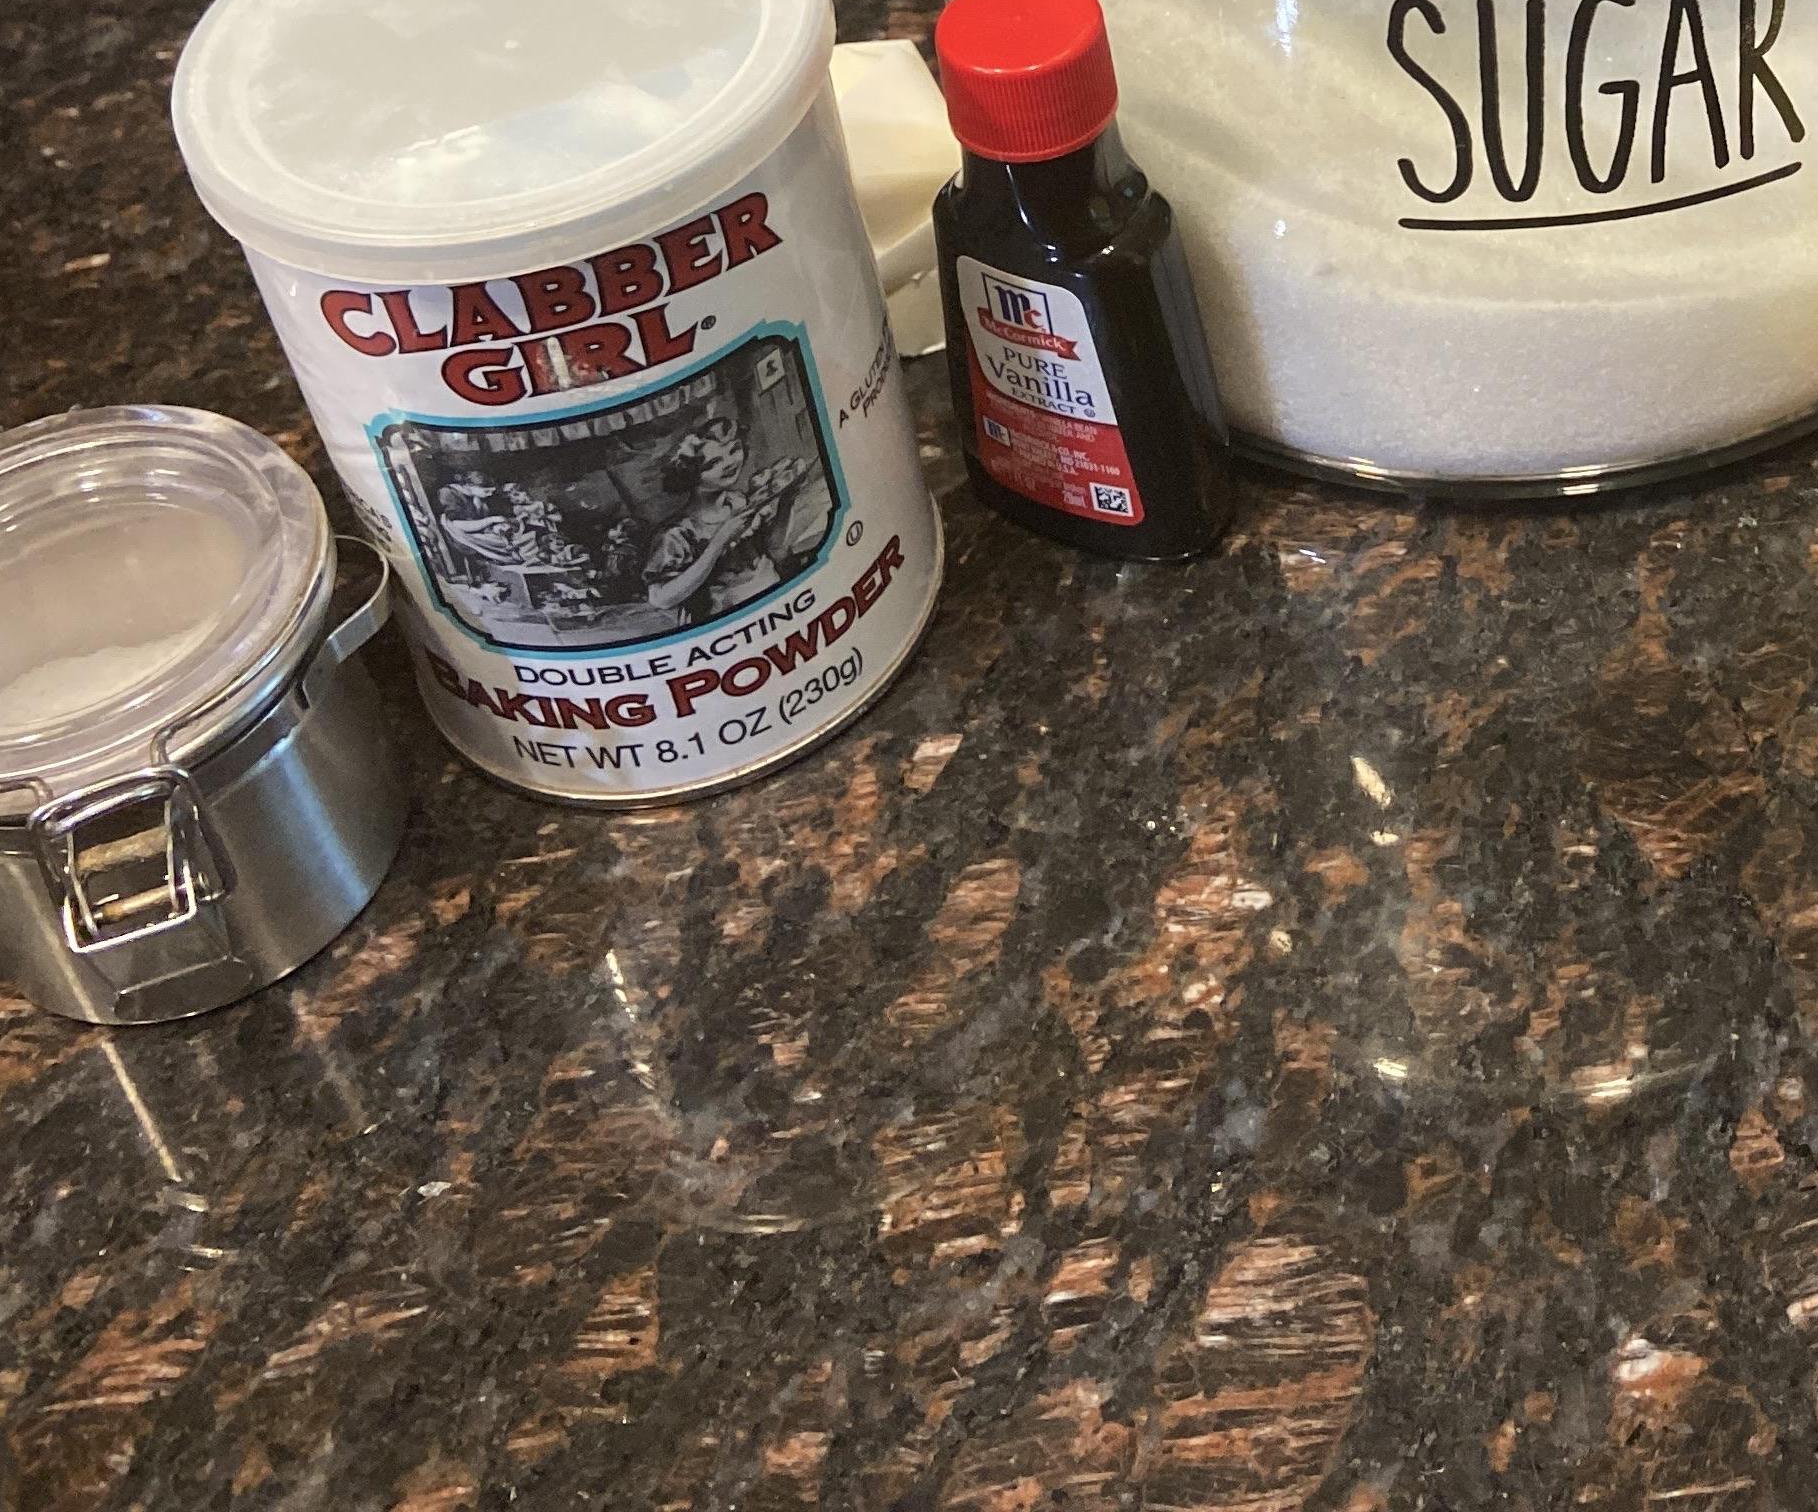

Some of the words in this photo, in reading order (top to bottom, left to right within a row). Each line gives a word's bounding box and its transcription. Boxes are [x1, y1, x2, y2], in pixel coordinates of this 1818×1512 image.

[320, 191, 783, 357] CLABBER
[441, 302, 698, 406] GIRL
[984, 316, 1066, 351] McCormick
[985, 354, 1094, 407] Vanilla
[1003, 346, 1067, 380] PURE
[1012, 389, 1076, 414] EXTRACT
[424, 645, 657, 729] BAKING
[666, 534, 904, 718] POWDER
[514, 655, 676, 686] DOUBLE
[687, 588, 816, 667] ACTING
[513, 736, 577, 768] NET
[586, 744, 644, 769] WT
[656, 732, 705, 763] 8.1
[718, 706, 772, 745] OZ
[779, 647, 862, 725] (230g)
